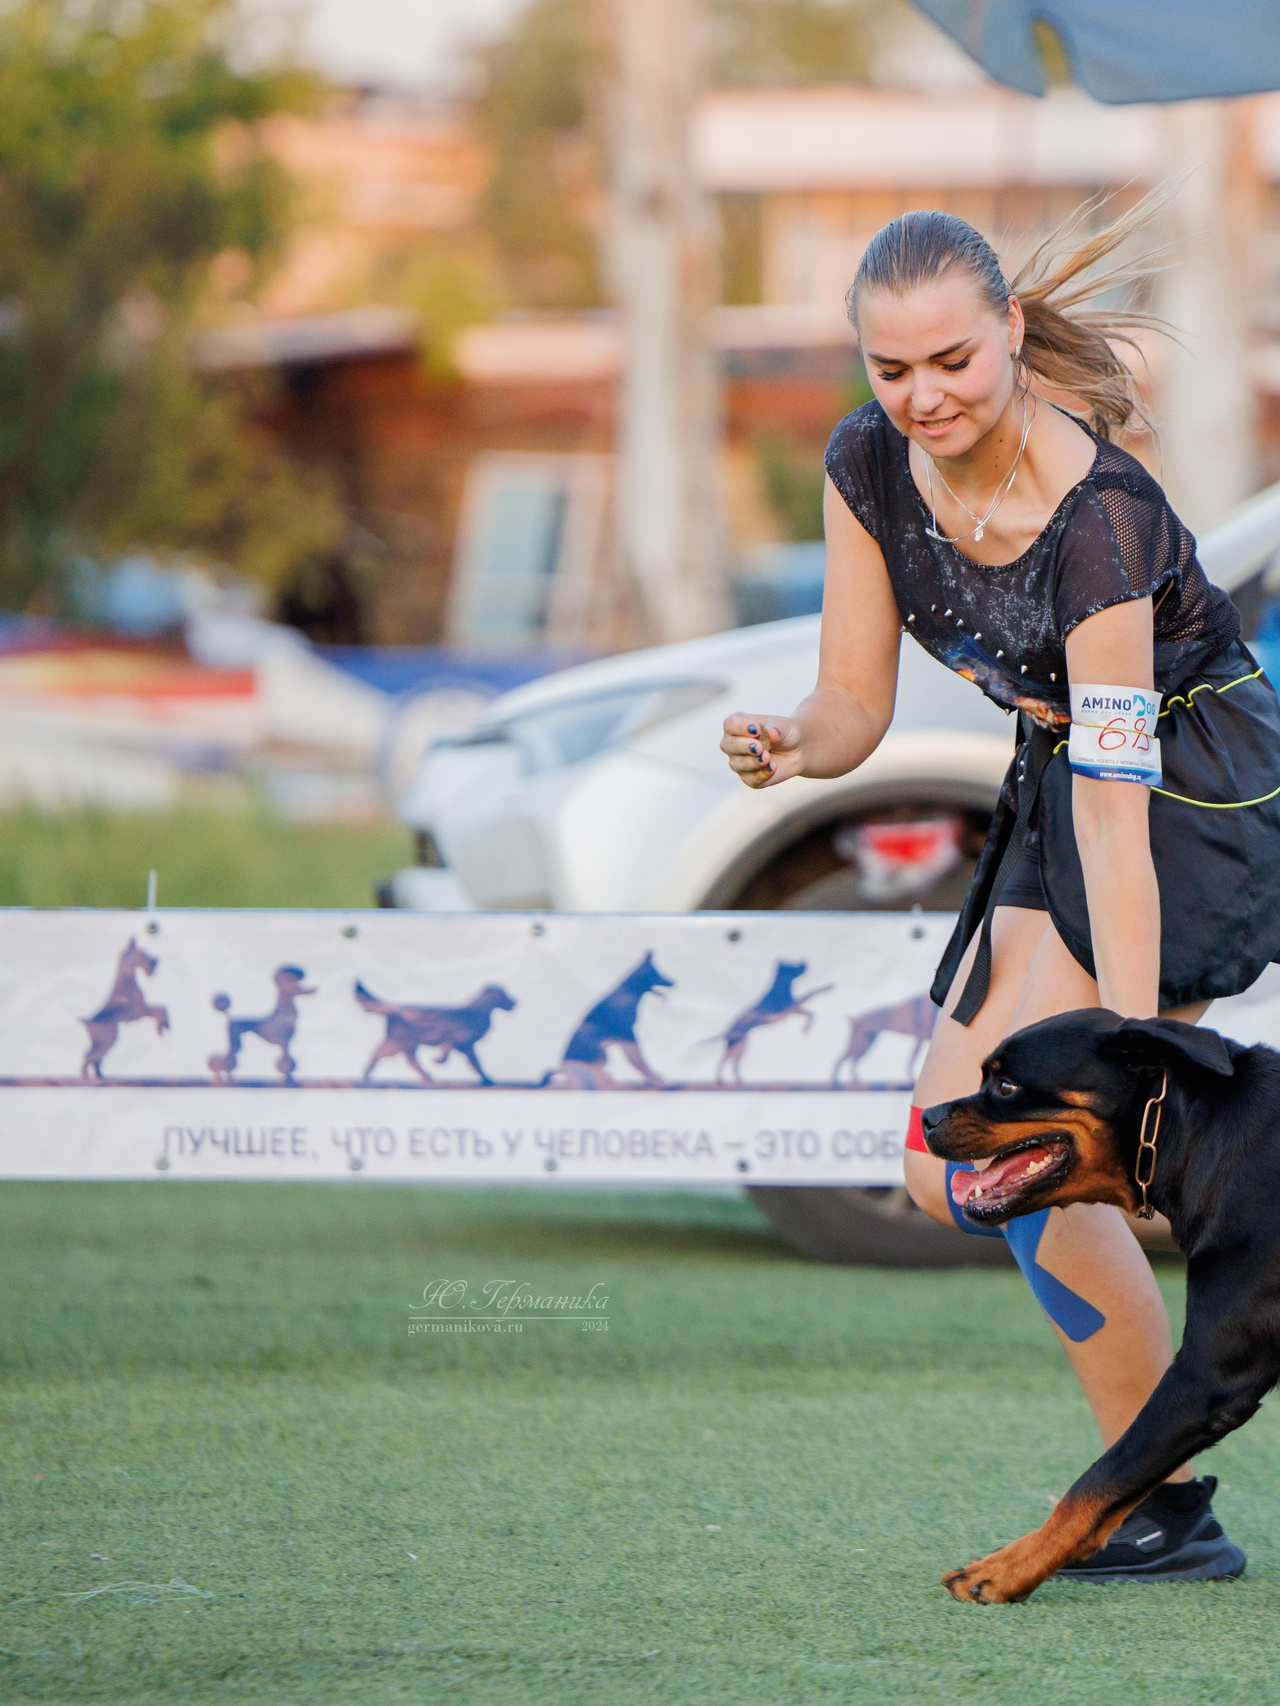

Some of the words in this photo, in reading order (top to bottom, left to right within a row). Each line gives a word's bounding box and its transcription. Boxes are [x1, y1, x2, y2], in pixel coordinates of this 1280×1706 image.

[1081, 694, 1155, 716] AMINODOG
[161, 1126, 319, 1161] ЛУЧШЕЕ,
[331, 1126, 396, 1157] ЧТО
[408, 1127, 494, 1158] ЕСТЬ
[500, 1127, 524, 1158] У
[535, 1128, 717, 1161] ЧЕЛОВЕКА
[755, 1128, 820, 1161] ЭТО
[831, 1129, 904, 1161] СОБ
